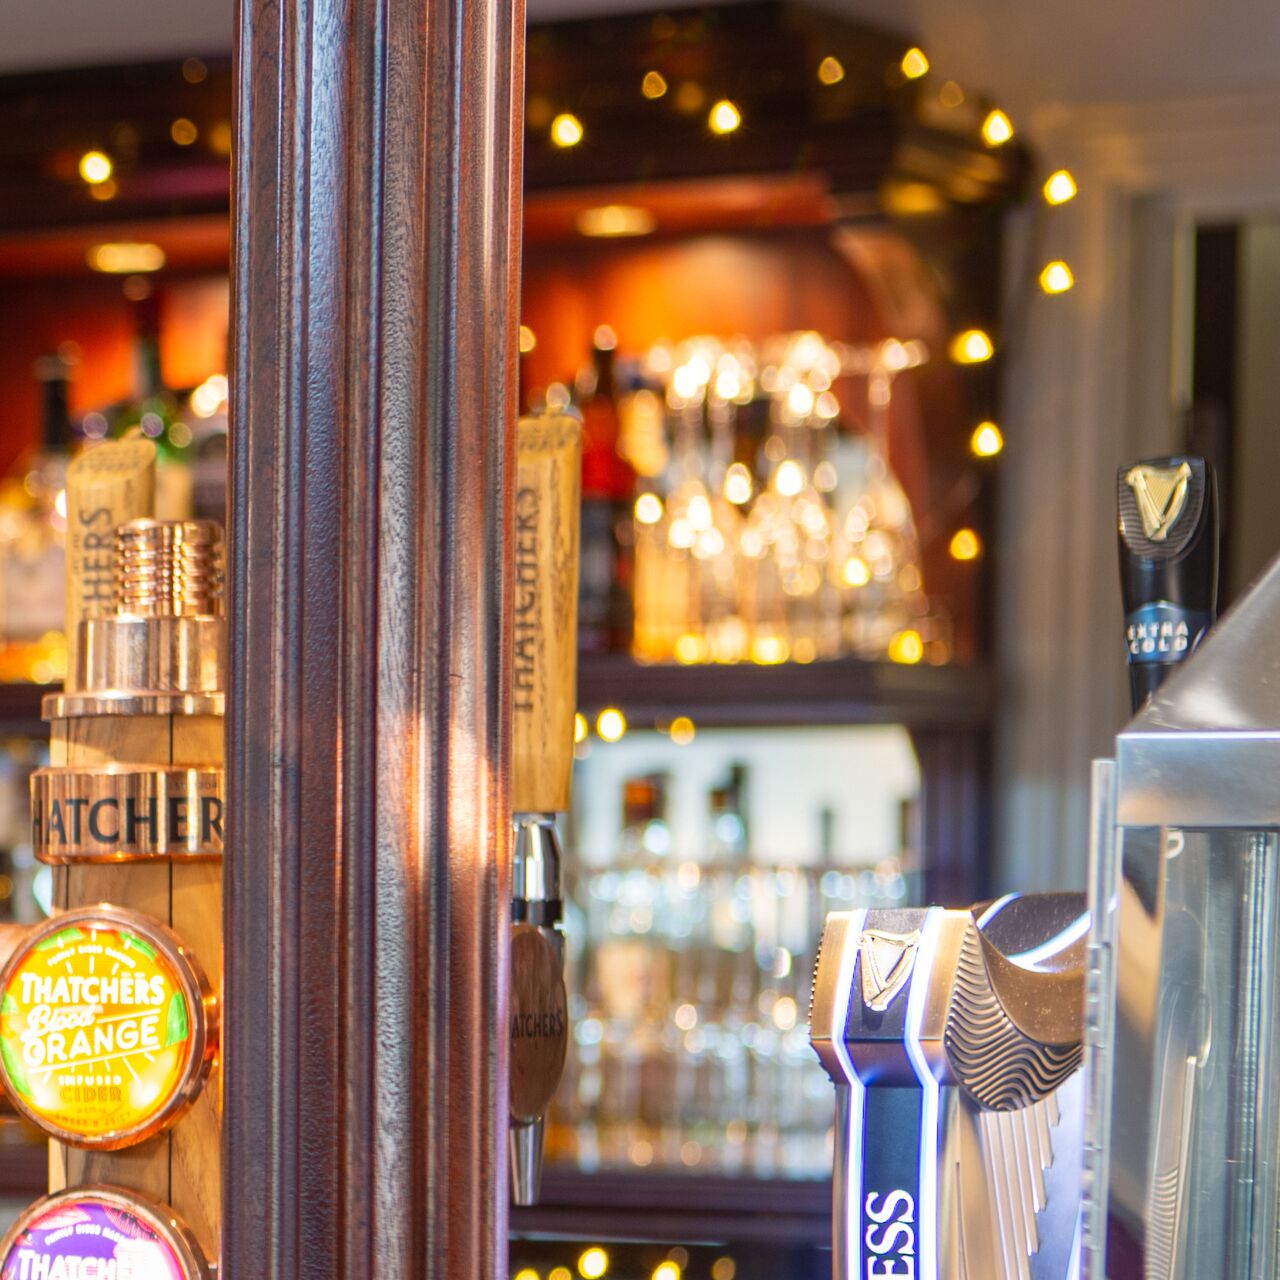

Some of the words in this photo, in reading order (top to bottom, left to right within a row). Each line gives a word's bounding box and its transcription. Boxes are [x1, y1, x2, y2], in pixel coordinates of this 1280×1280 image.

[1126, 621, 1189, 640] EXTRA
[1129, 636, 1188, 654] COLD
[20, 971, 165, 1006] THATCHERS
[26, 1003, 98, 1037] Blood
[20, 1015, 160, 1067] ORANGE
[59, 1086, 122, 1103] CIDER
